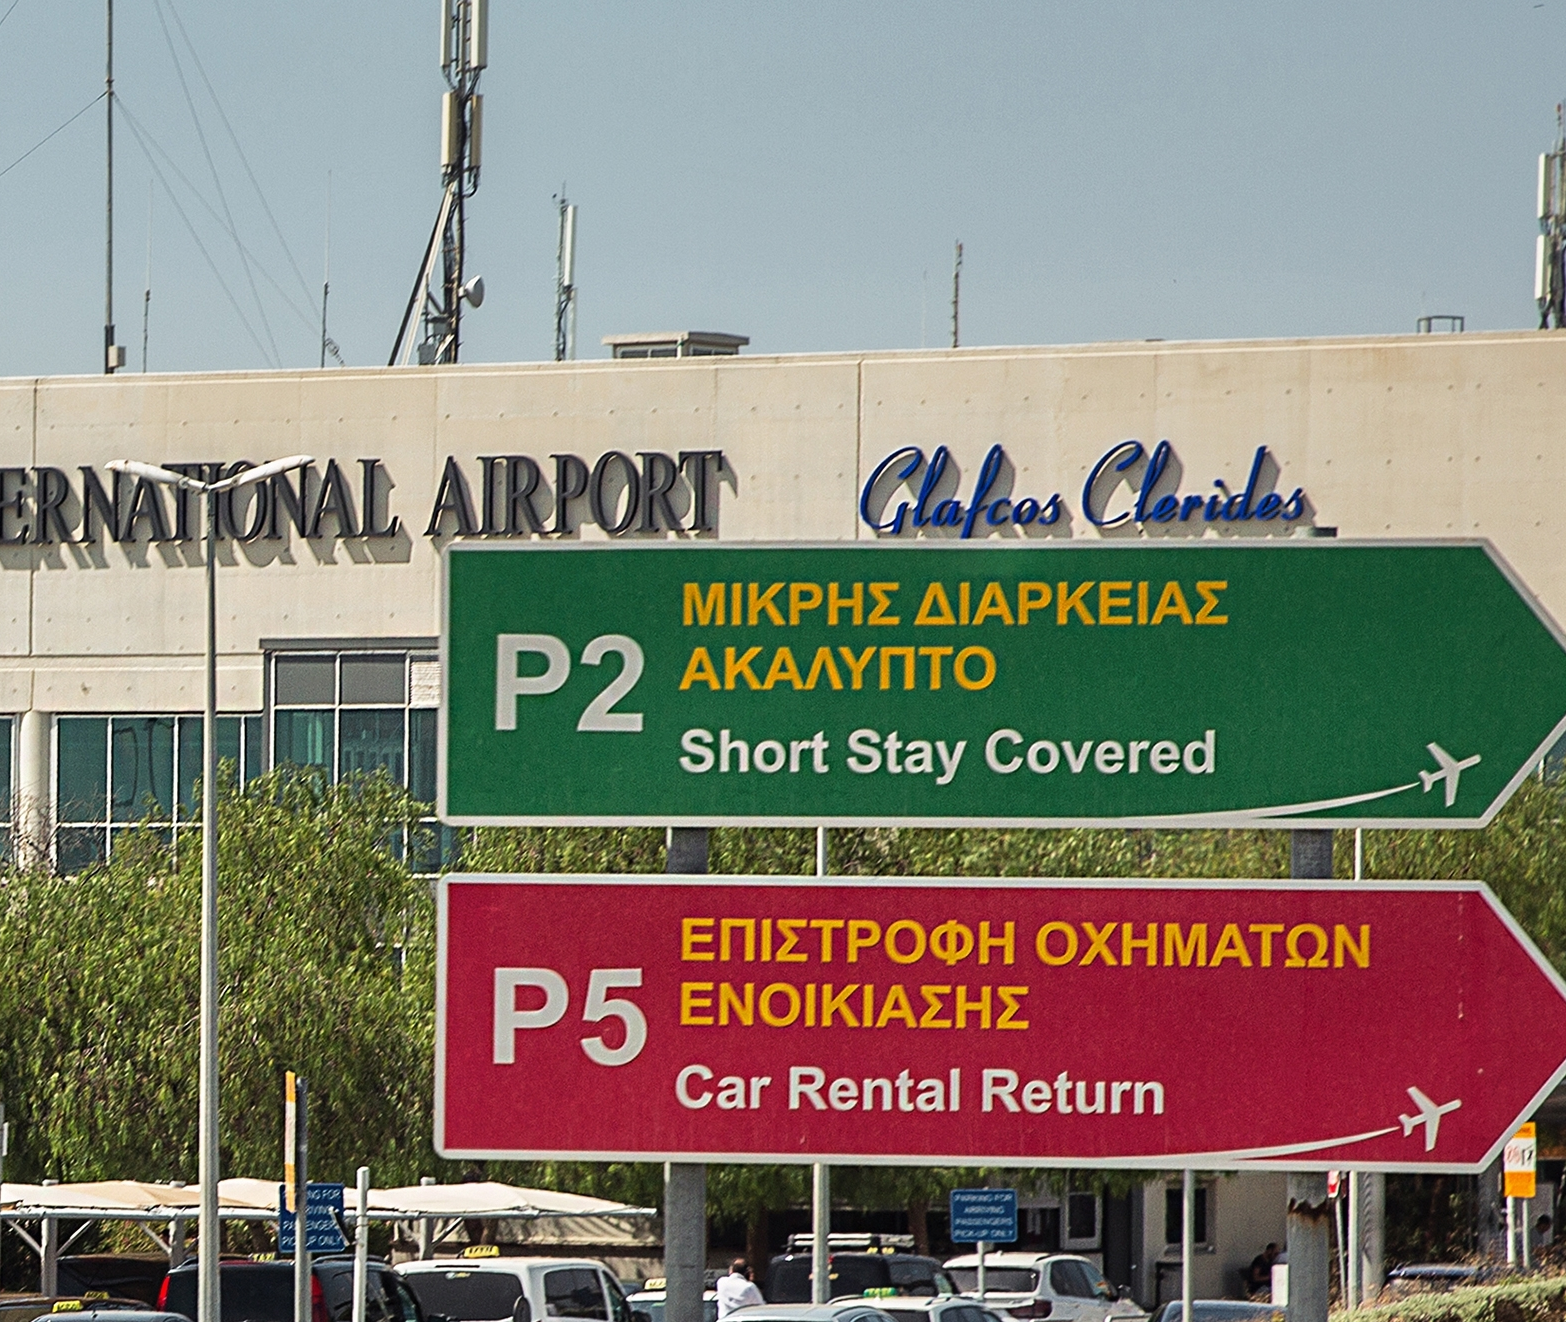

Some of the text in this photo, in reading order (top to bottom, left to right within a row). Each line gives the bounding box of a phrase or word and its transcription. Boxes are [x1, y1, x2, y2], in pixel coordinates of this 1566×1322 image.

[423, 450, 724, 538] AIRPORT
[860, 440, 1304, 539] Glafcos Clerides
[681, 580, 1228, 626] ΜΙΚΡΗΣ ΔΙΑΡΚΕΙΑΣ
[494, 632, 646, 733] P2
[679, 645, 997, 691] ΑΚΑΛΥΠΤΟ
[679, 730, 1217, 785] Short Stay Covered
[680, 918, 1371, 969] ΕΠΙΣΤΡΟΦΗ ΟΧΗΜΑΤΩΝ
[492, 967, 648, 1067] P5
[679, 983, 1030, 1030] ΕΝΟΙΚΙΑΣΗΣ
[674, 1065, 1165, 1116] Car Rental Return
